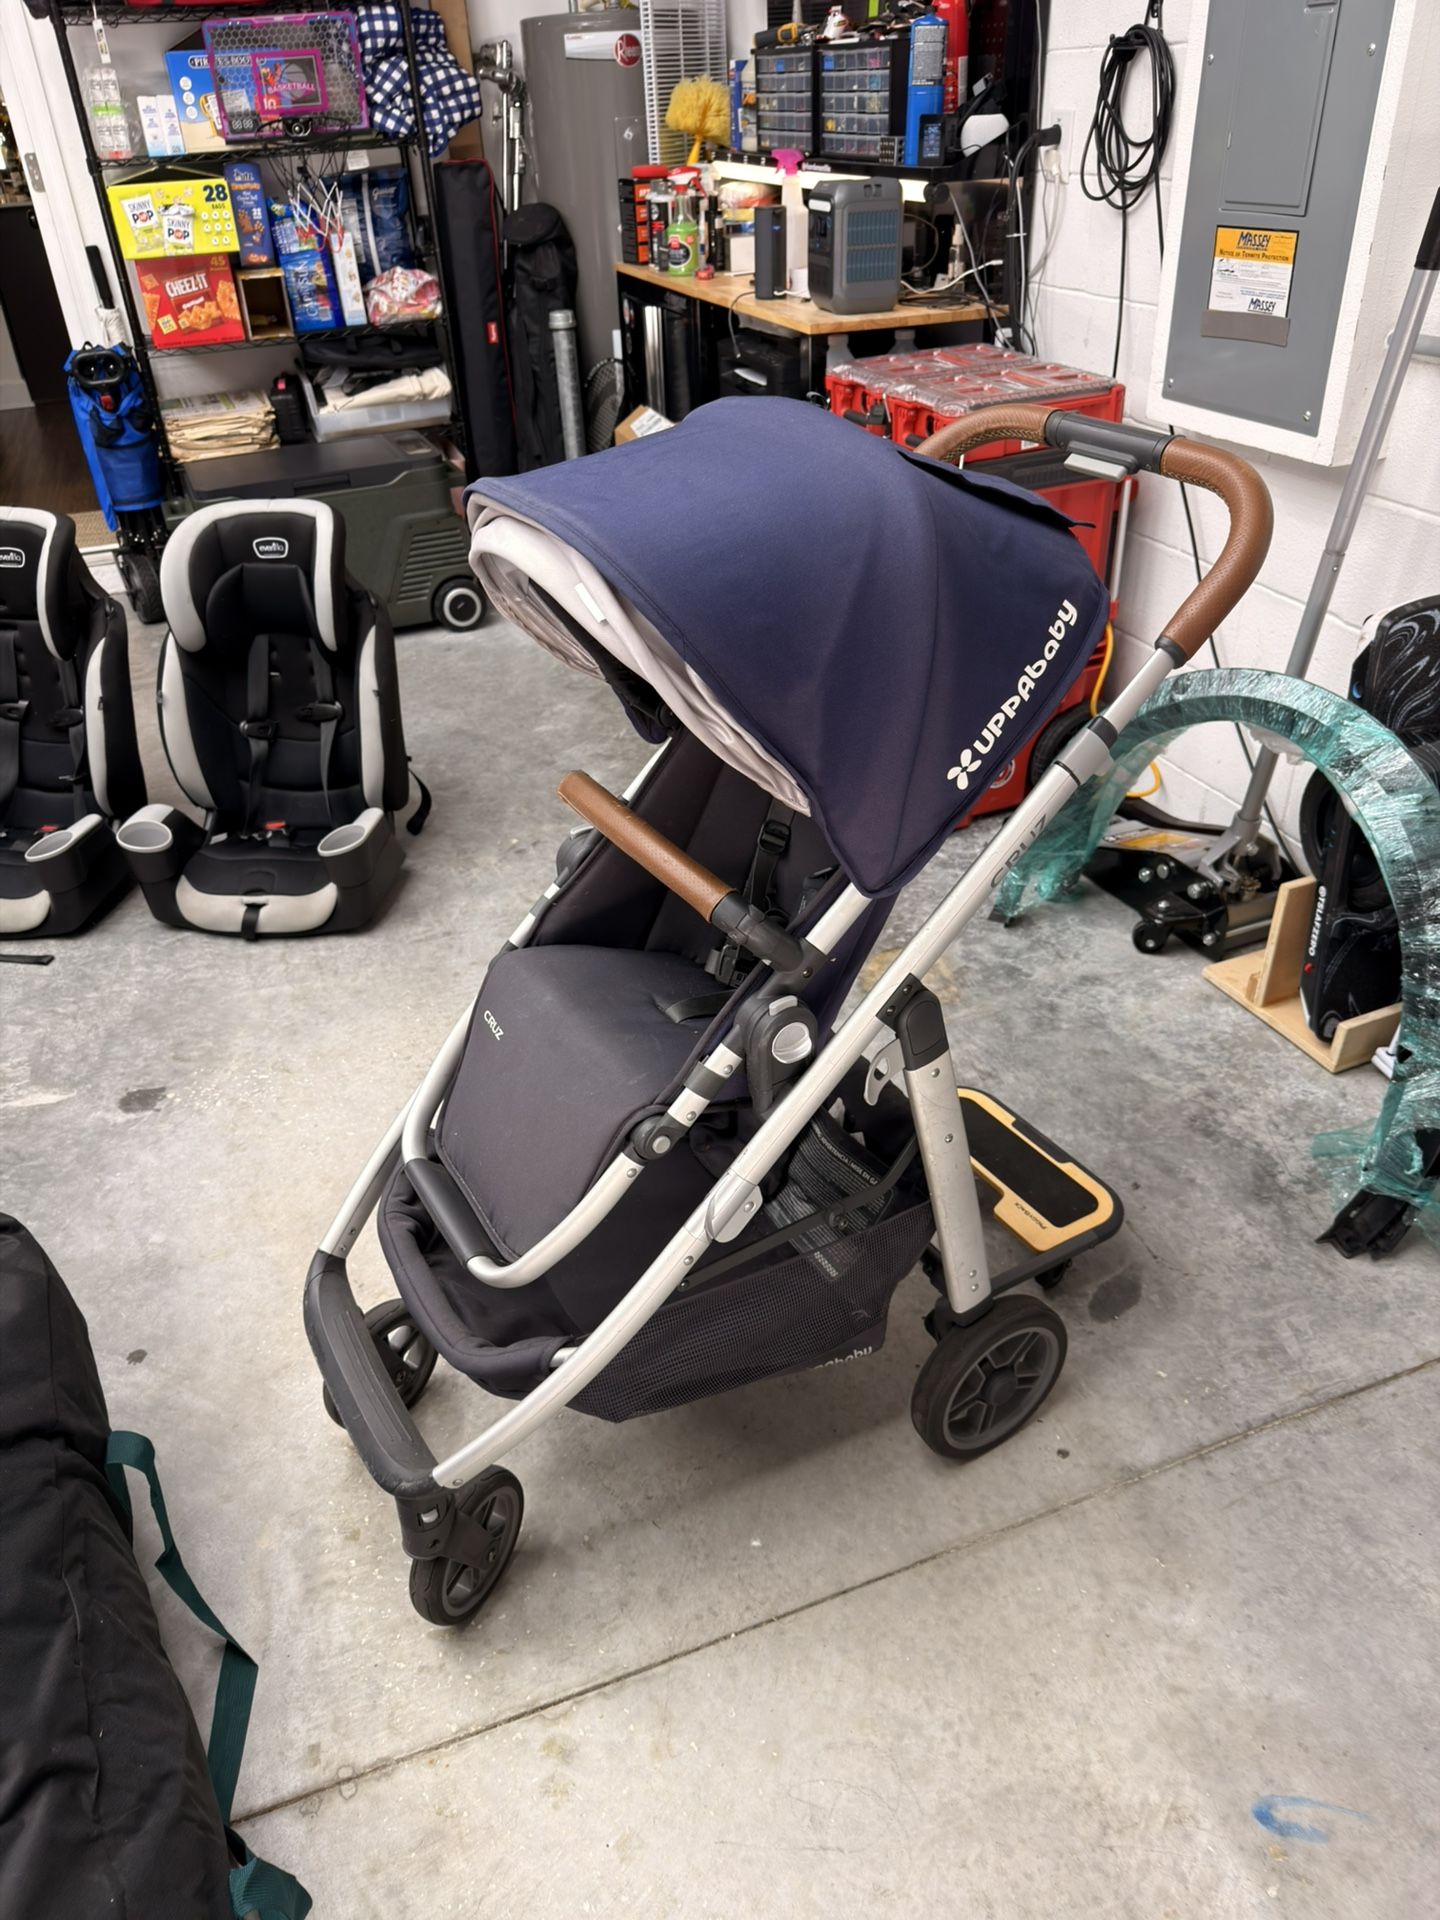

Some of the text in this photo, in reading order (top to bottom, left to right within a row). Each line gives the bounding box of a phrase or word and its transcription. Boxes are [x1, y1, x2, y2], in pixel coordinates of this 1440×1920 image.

[267, 81, 316, 95] BASKETBALL
[203, 184, 228, 202] 28
[128, 199, 151, 212] SKINNY
[132, 210, 154, 224] POP
[167, 218, 190, 229] SKINNY
[168, 228, 190, 240] POP
[1237, 231, 1272, 248] MASSEY
[1247, 297, 1277, 313] MASSEY
[973, 599, 1078, 755] UPPAbaby
[484, 1010, 504, 1041] CRUZ
